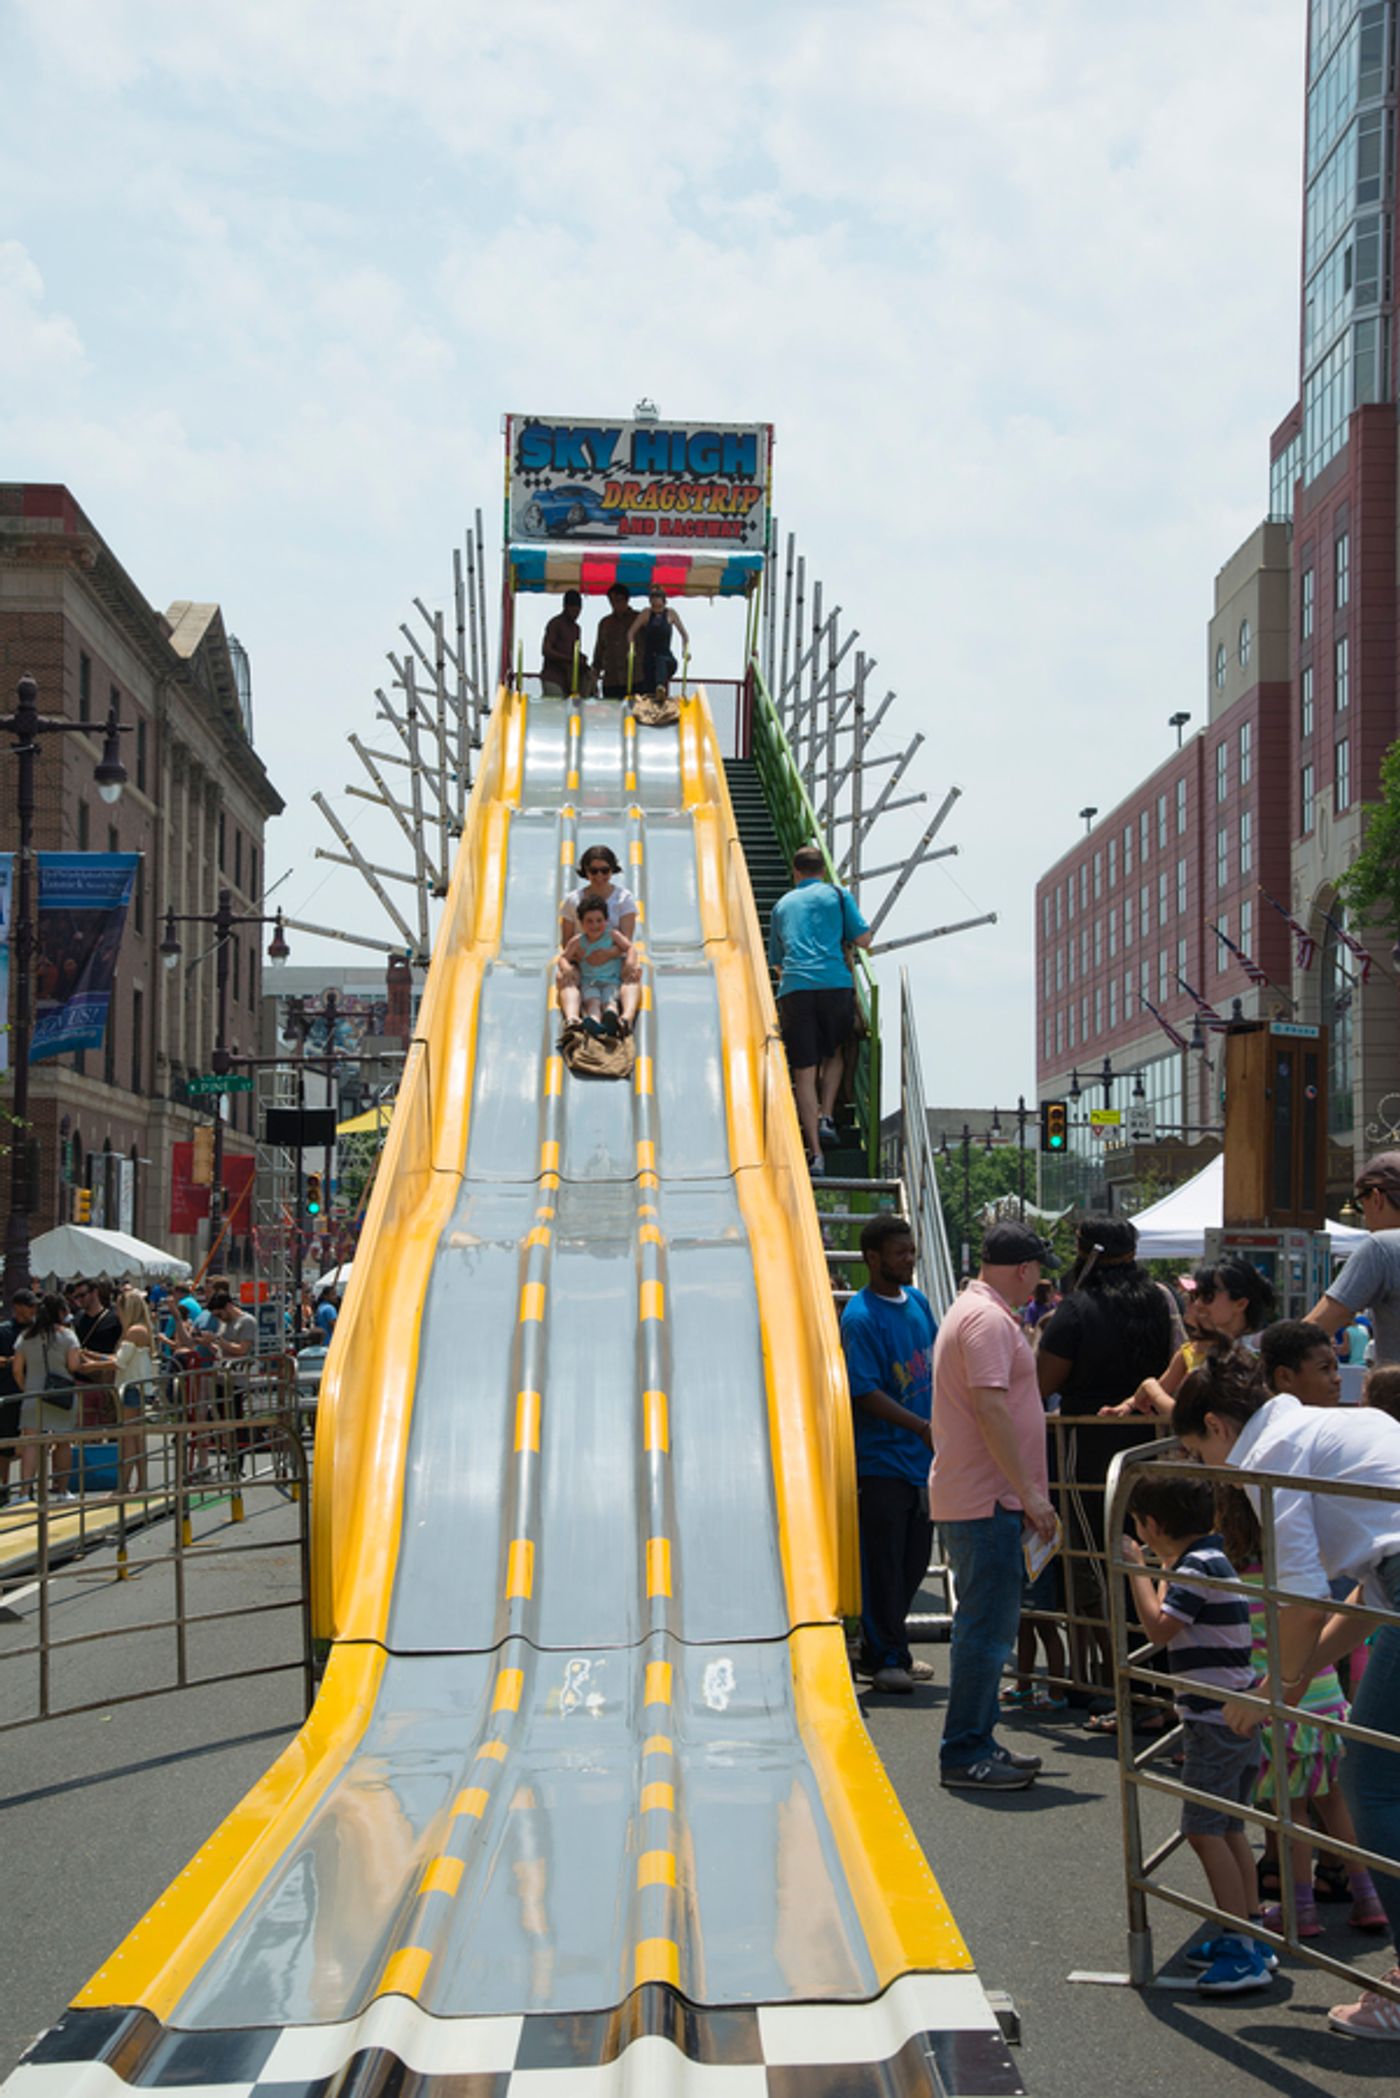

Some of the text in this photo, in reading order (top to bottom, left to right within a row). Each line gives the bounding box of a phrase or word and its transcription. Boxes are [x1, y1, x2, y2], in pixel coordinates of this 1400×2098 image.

[519, 425, 758, 476] SKY HIGH
[601, 480, 763, 514] DRAGSTRIP
[618, 516, 745, 538] AND RACEWAY
[1130, 1110, 1150, 1119] ONE
[1130, 1121, 1150, 1129] WAY
